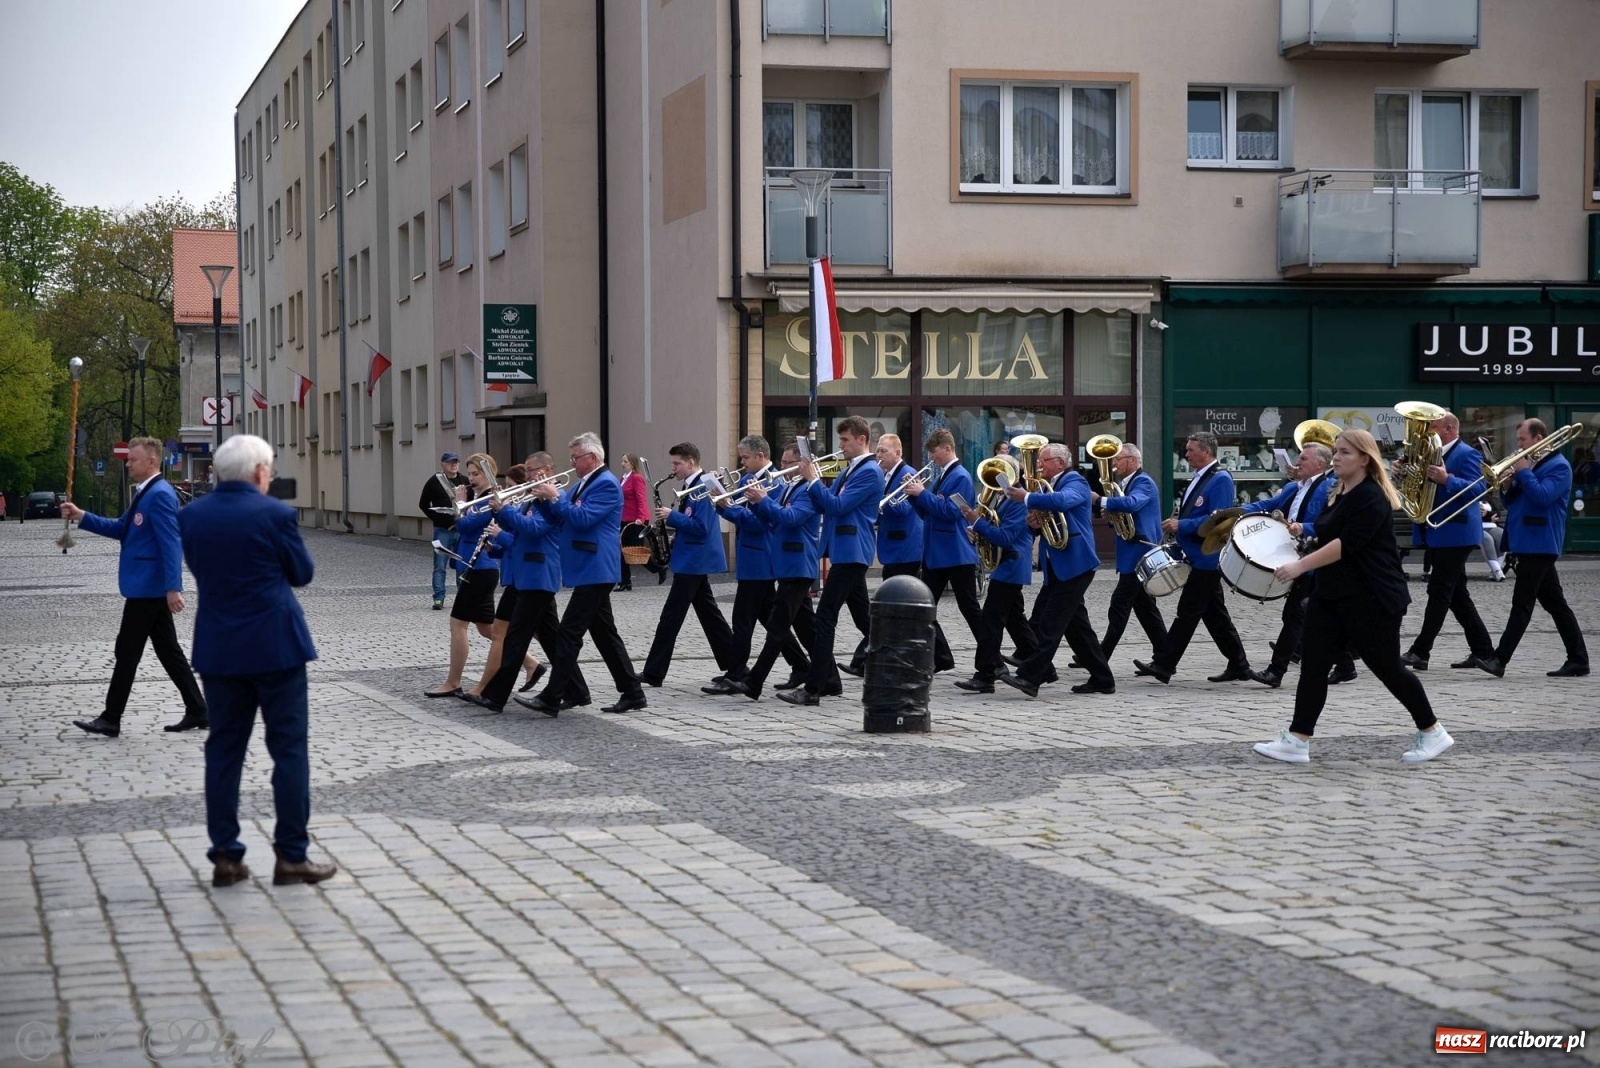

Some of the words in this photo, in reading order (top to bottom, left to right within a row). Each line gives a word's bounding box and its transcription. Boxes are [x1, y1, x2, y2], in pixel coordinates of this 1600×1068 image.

[1424, 325, 1597, 356] JUBIL
[1482, 364, 1524, 375] 1989
[1205, 409, 1237, 420] Pierre
[1210, 416, 1246, 435] Ricaud
